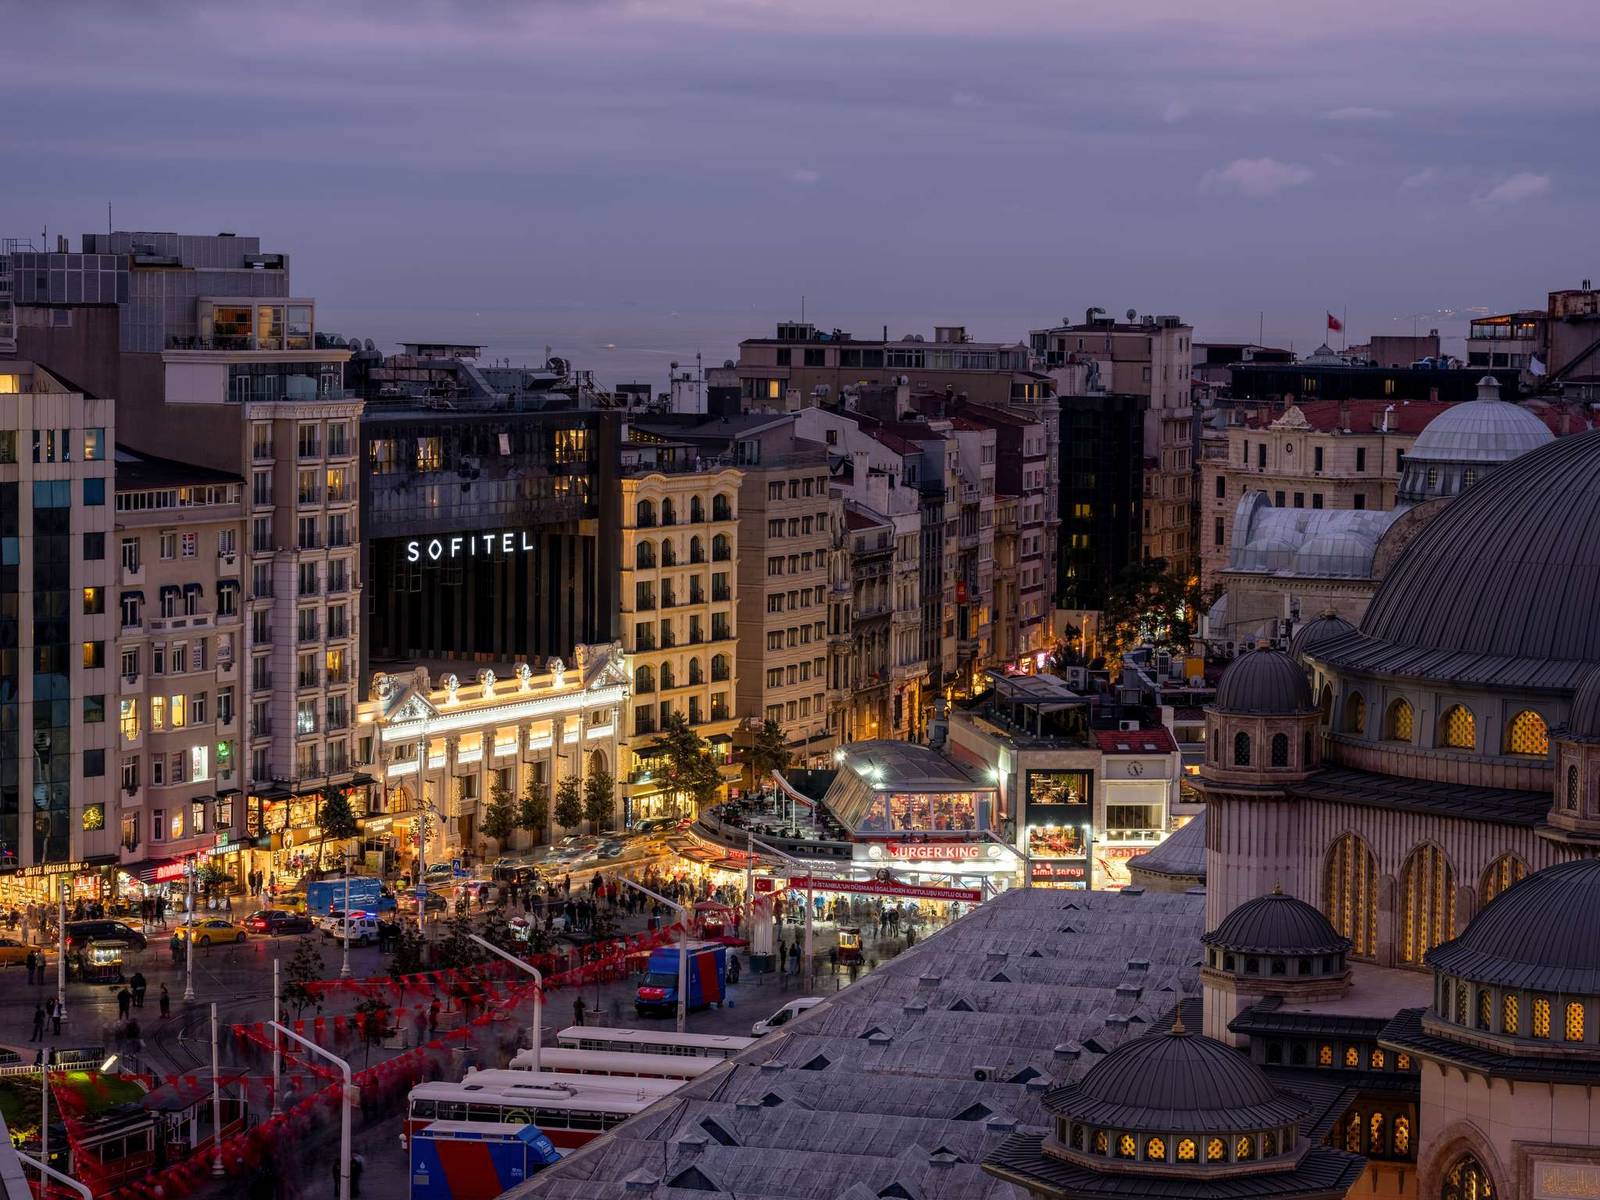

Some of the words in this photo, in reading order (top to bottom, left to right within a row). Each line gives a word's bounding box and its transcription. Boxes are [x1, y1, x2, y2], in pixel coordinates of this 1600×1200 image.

[407, 531, 534, 562] SOFITEL
[890, 846, 942, 858] BURGER
[946, 846, 979, 858] KING
[1109, 848, 1149, 858] Pehliv
[1032, 863, 1054, 876] simit
